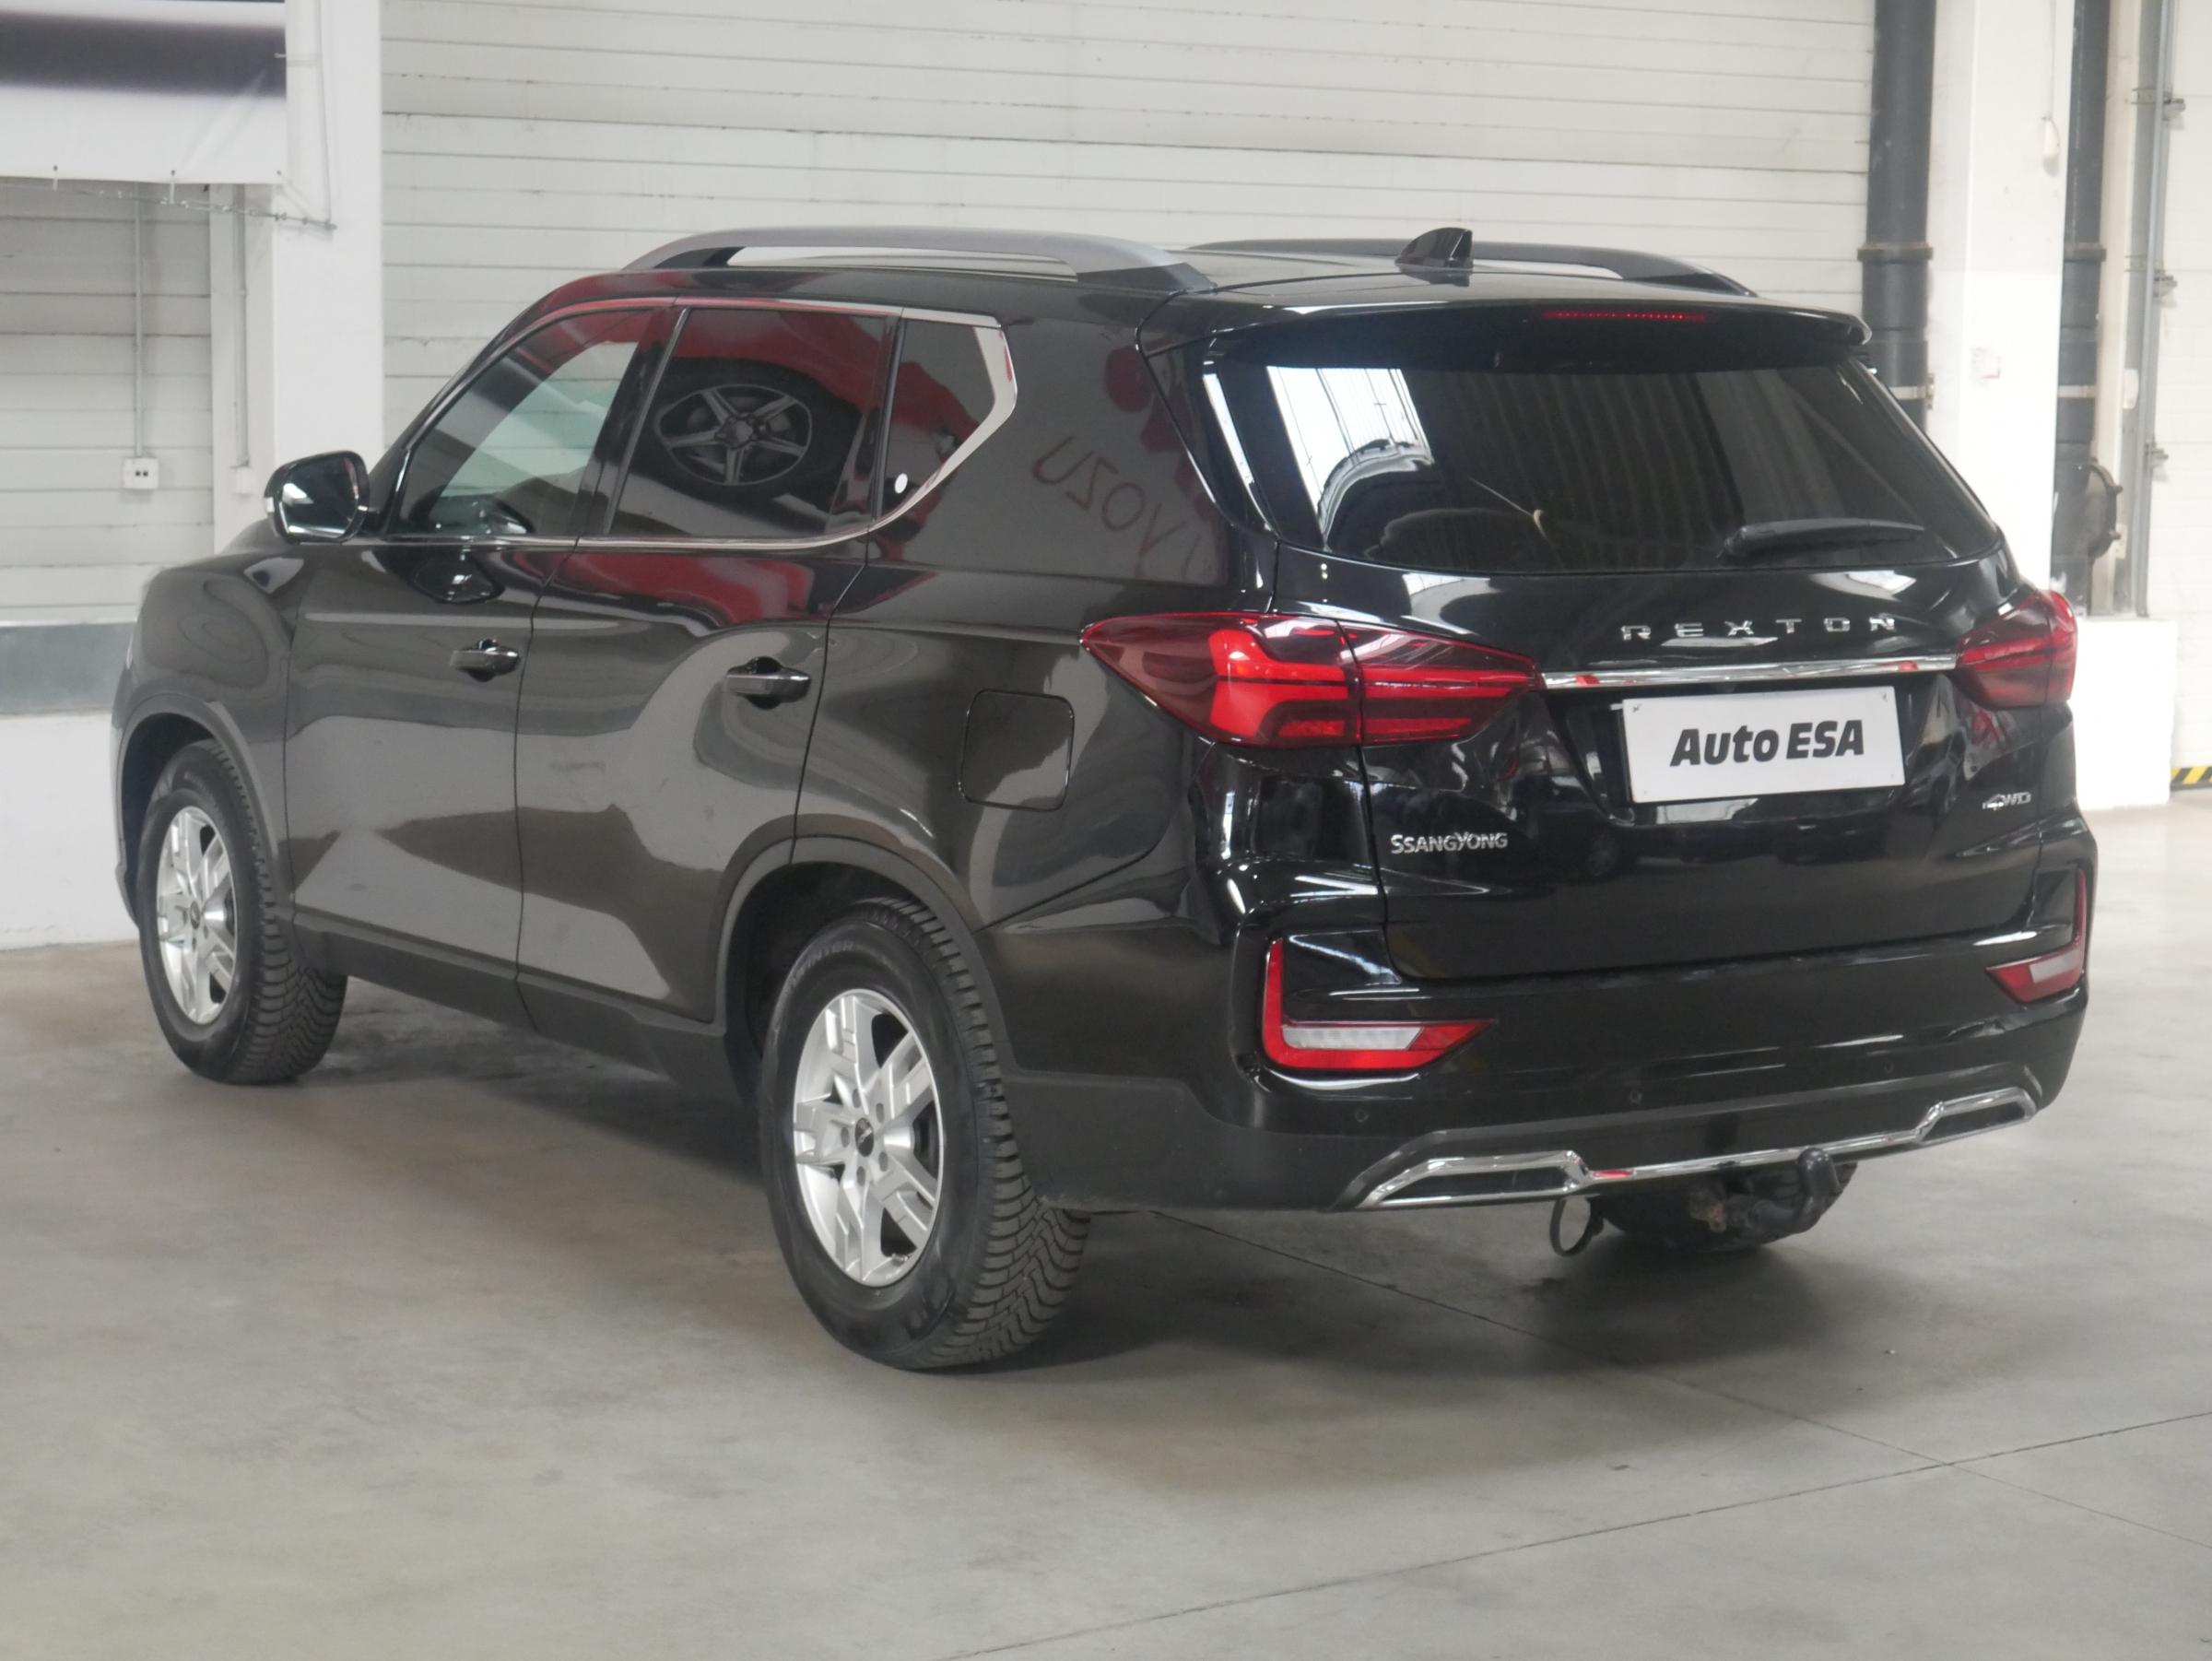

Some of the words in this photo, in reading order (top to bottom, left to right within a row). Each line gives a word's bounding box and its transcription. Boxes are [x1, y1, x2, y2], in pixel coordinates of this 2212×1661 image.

[1620, 616, 1896, 642] REXTON
[1669, 724, 1780, 768] Auto
[1786, 719, 1865, 760] ESA
[1982, 791, 2032, 811] 4WD
[1390, 831, 1509, 854] SSANGYONG
